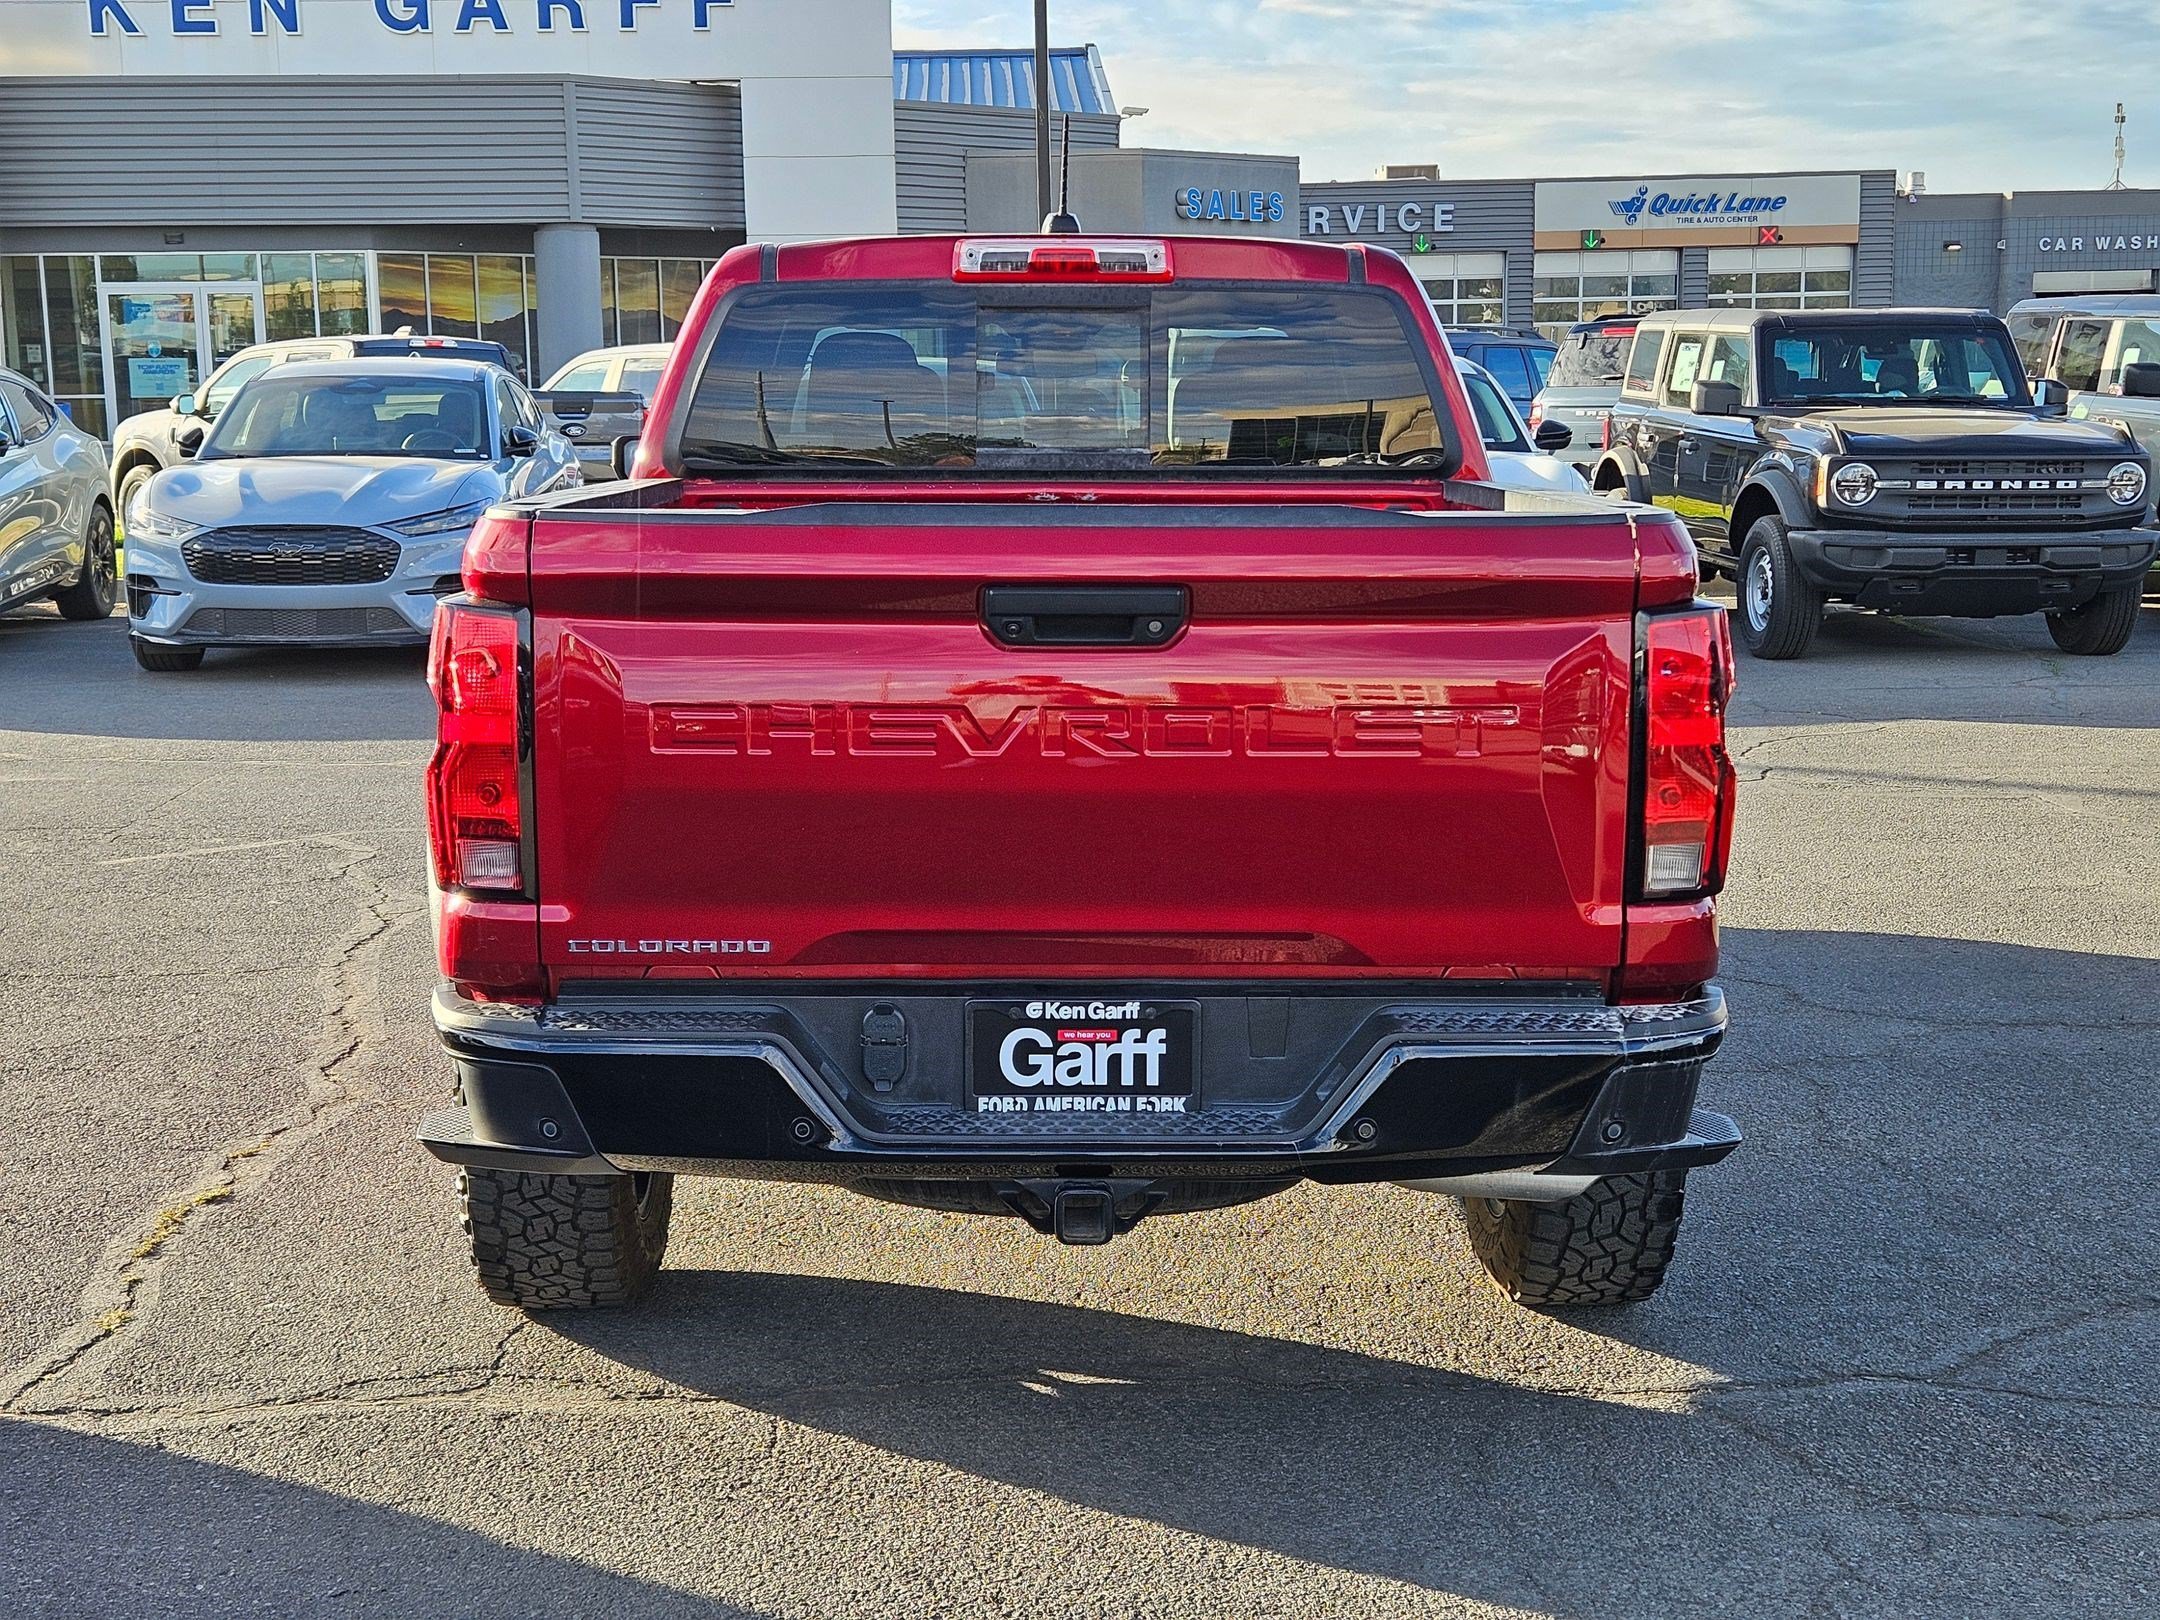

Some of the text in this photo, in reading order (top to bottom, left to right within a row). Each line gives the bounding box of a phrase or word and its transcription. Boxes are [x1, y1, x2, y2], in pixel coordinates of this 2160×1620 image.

[1184, 187, 1285, 222] SALES
[1649, 192, 1787, 217] Quick Lane
[1308, 202, 1455, 234] RVICE
[1676, 216, 1695, 224] TIRE
[1703, 216, 1725, 224] AUTO
[1726, 215, 1759, 224] CENTER
[2039, 235, 2158, 251] CAR WASH
[1916, 480, 2077, 490] BRONCO
[648, 703, 1521, 757] CHEVROLET
[567, 939, 771, 953] COLORADO
[1045, 1002, 1141, 1020] Ken Garff
[1076, 1030, 1095, 1038] hear
[1096, 1031, 1111, 1040] you
[999, 1027, 1167, 1087] Garff
[978, 1097, 1186, 1113] FORD AMERICAN FORK
